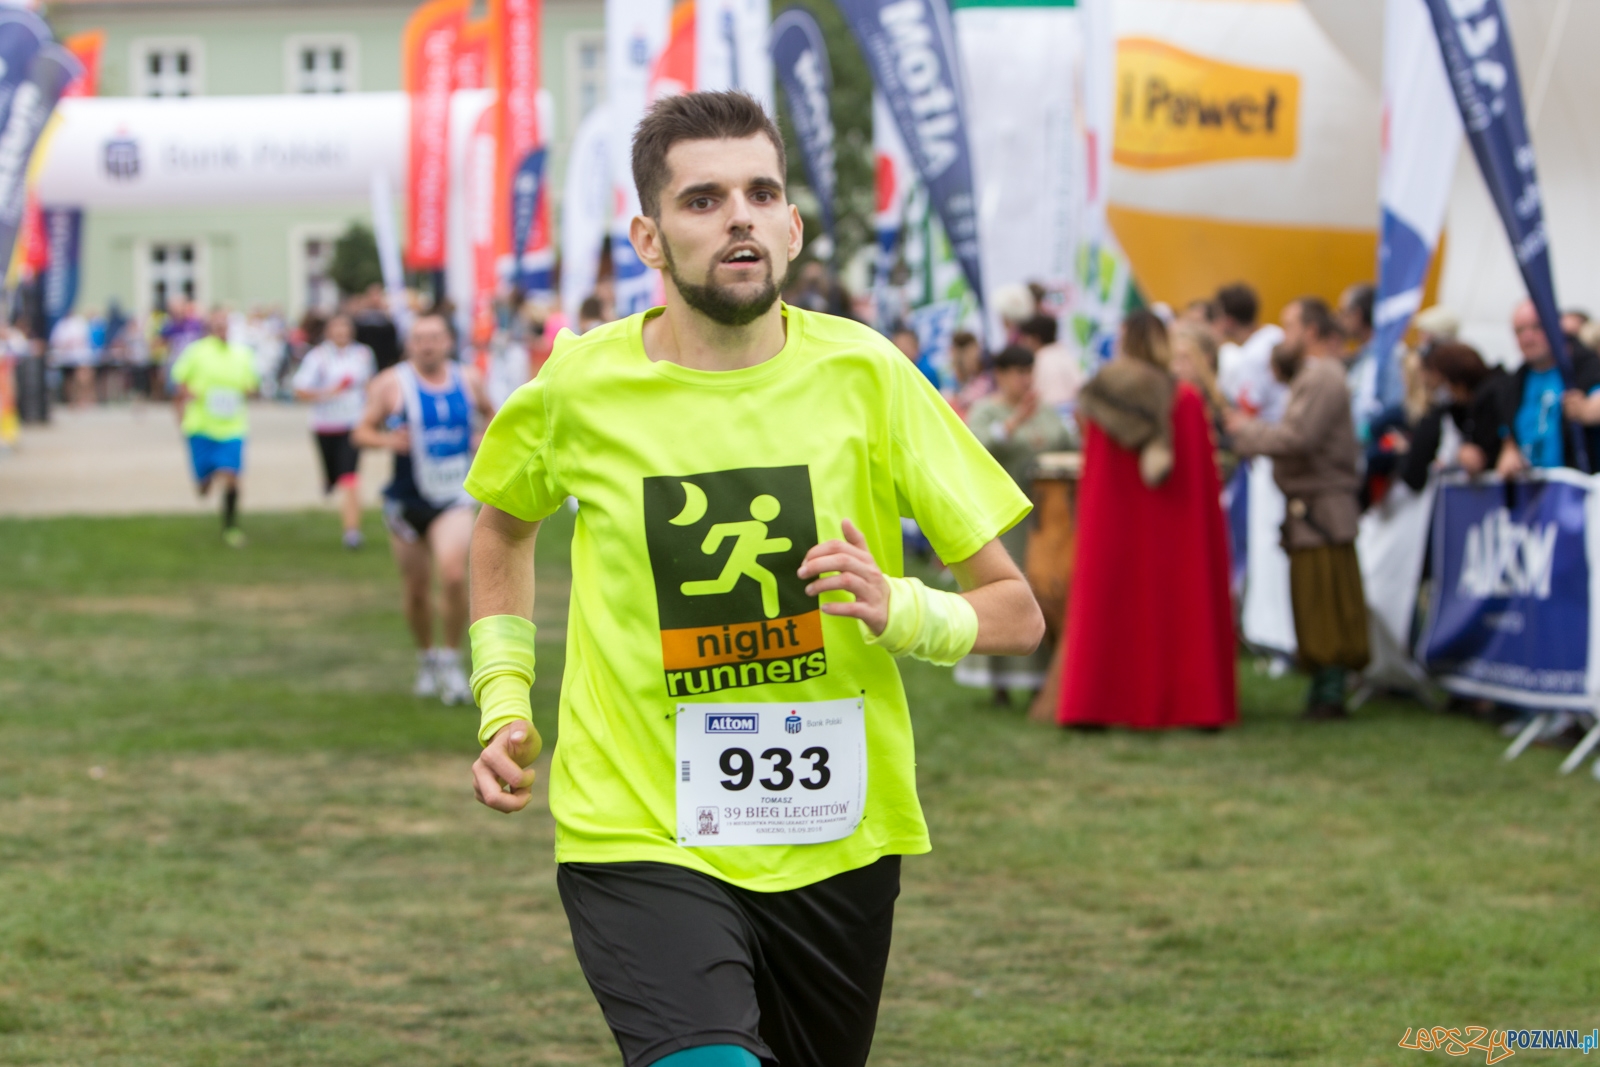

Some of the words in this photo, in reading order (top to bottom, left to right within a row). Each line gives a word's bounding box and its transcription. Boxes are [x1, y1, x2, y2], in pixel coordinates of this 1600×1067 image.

[696, 618, 800, 661] night
[666, 651, 827, 696] runners
[806, 719, 823, 728] Bank
[825, 717, 843, 726] Polski
[718, 746, 831, 792] 933
[724, 806, 741, 820] 39
[746, 806, 779, 819] BIEG
[784, 800, 850, 818] LECHITÓW
